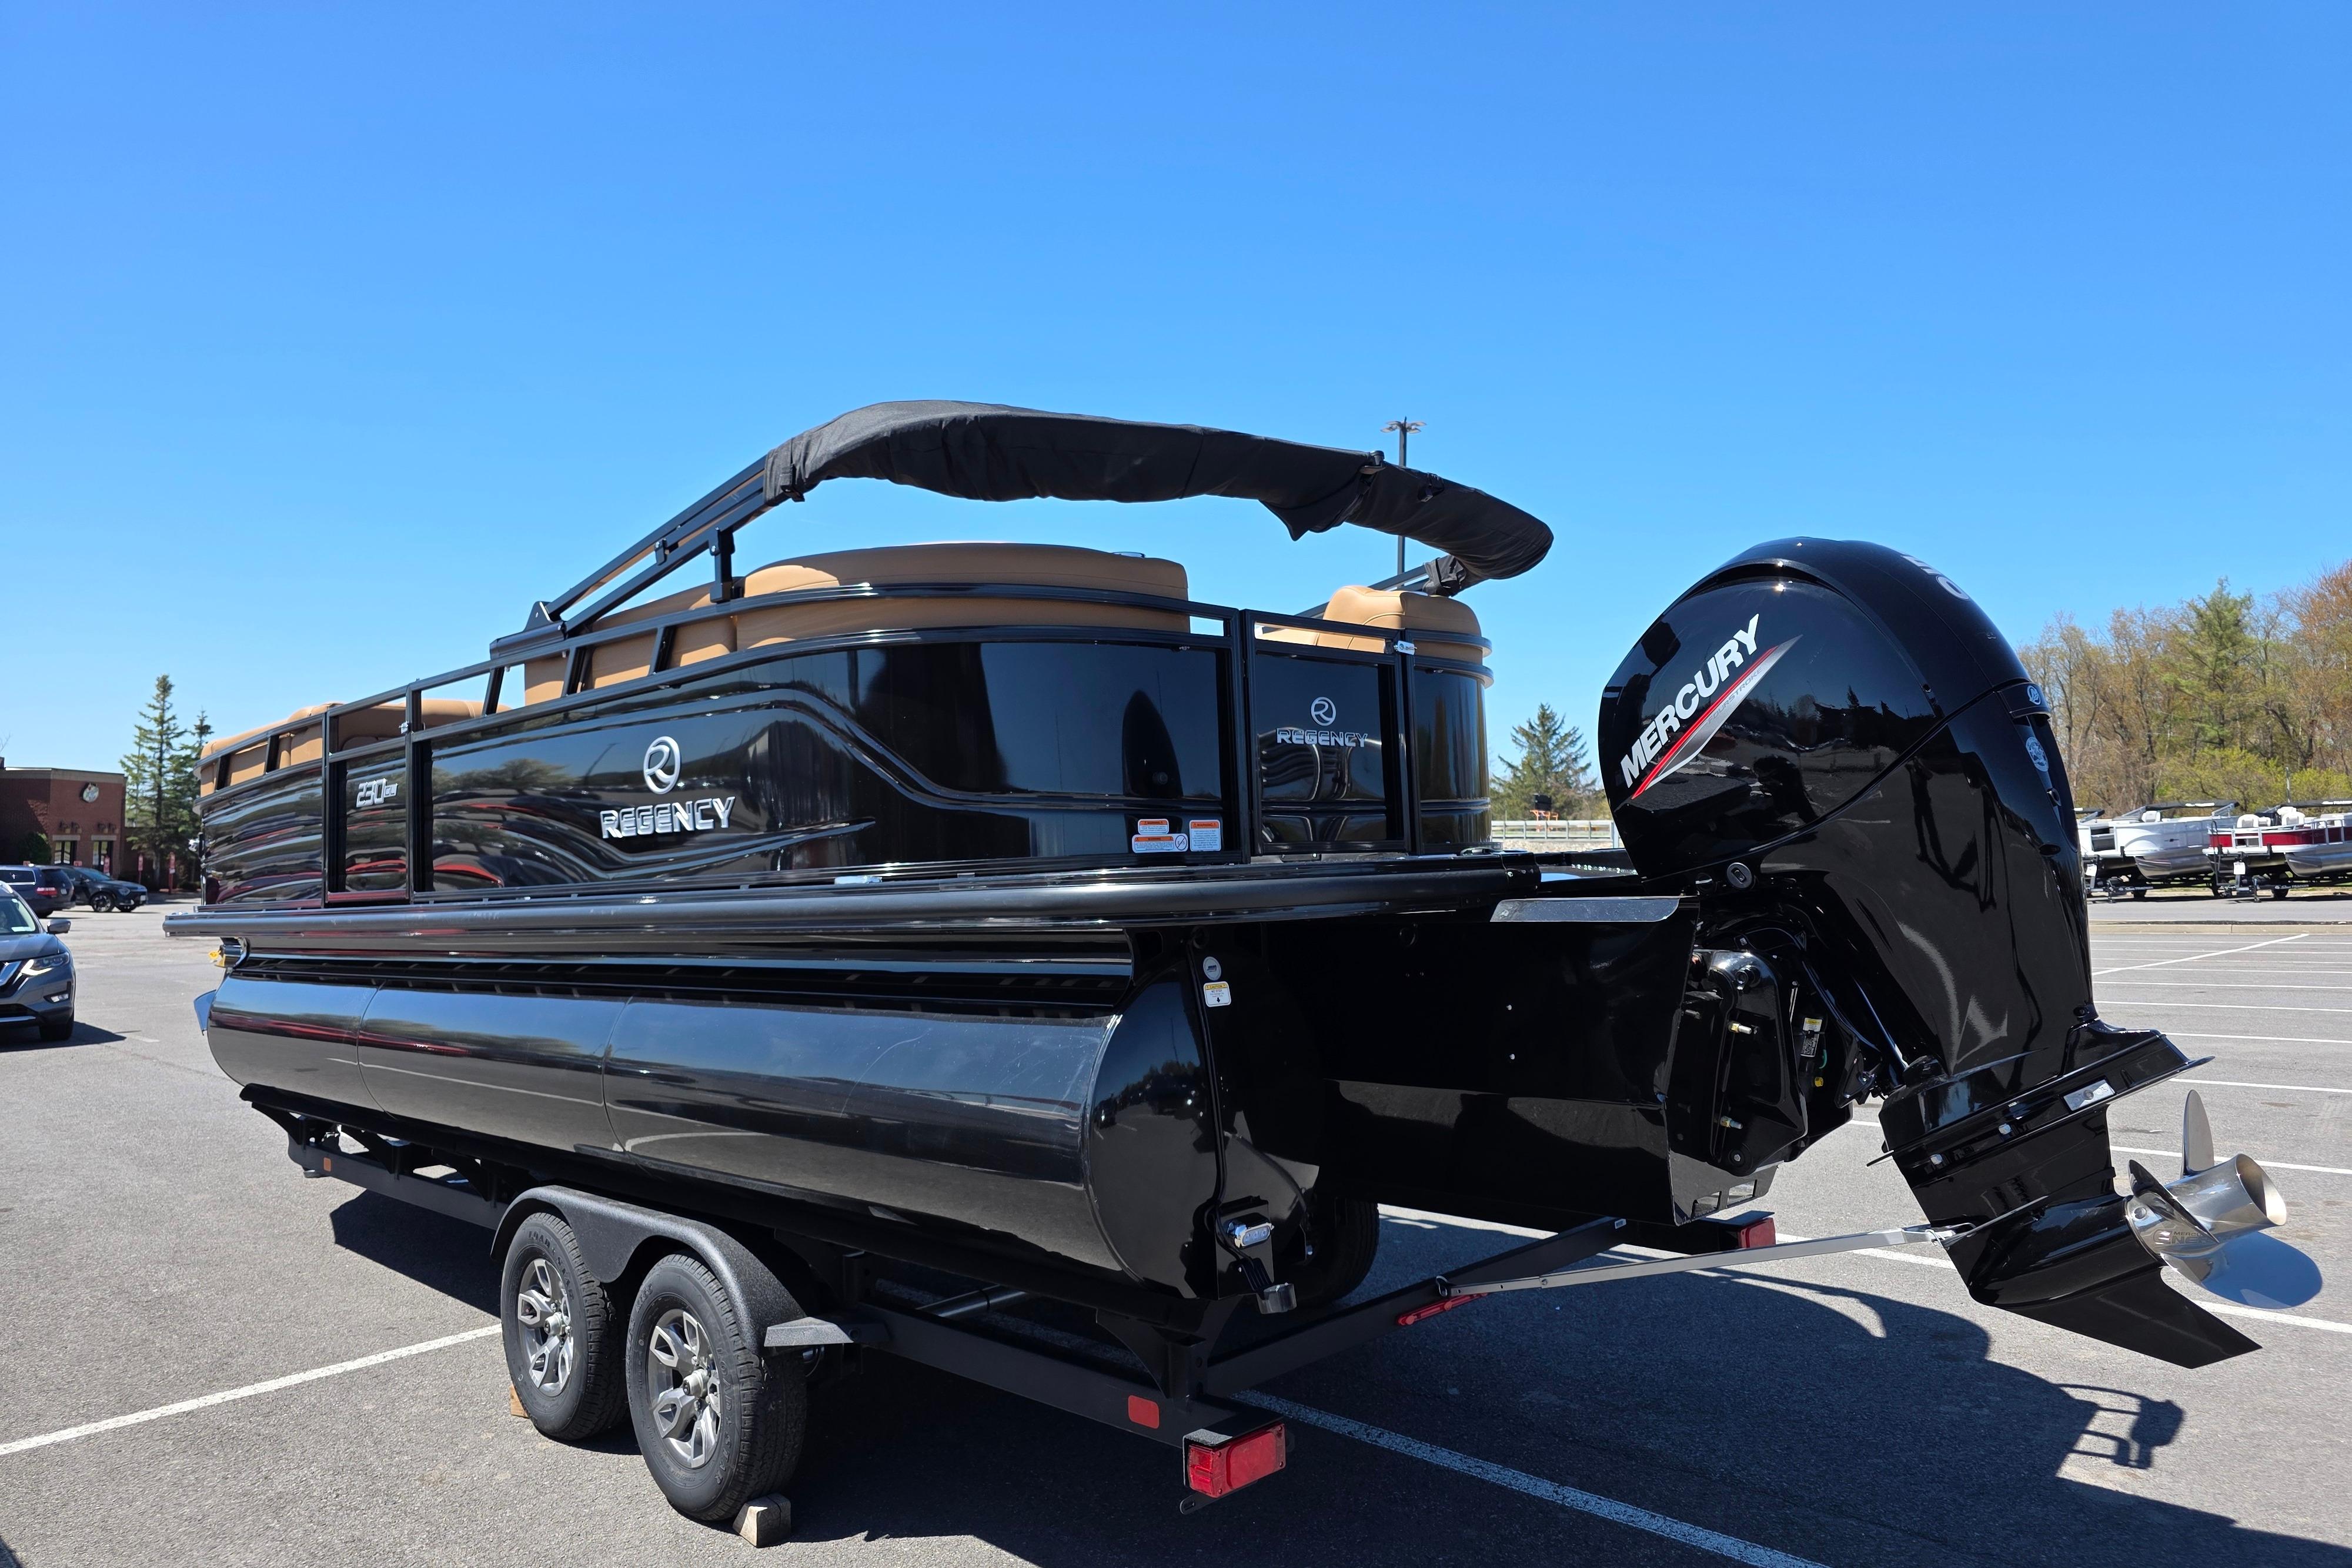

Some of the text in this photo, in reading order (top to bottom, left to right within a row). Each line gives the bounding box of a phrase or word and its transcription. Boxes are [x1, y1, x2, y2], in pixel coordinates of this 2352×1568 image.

[1621, 614, 1759, 788] MERCURY
[1706, 666, 1763, 725] FOURSTROKE
[1277, 728, 1368, 747] REGENCY
[356, 779, 386, 807] 230
[600, 796, 735, 839] REGENCY
[529, 1231, 551, 1249] LOAD
[2153, 1229, 2207, 1245] ENER
[716, 1348, 733, 1411] LOAD
